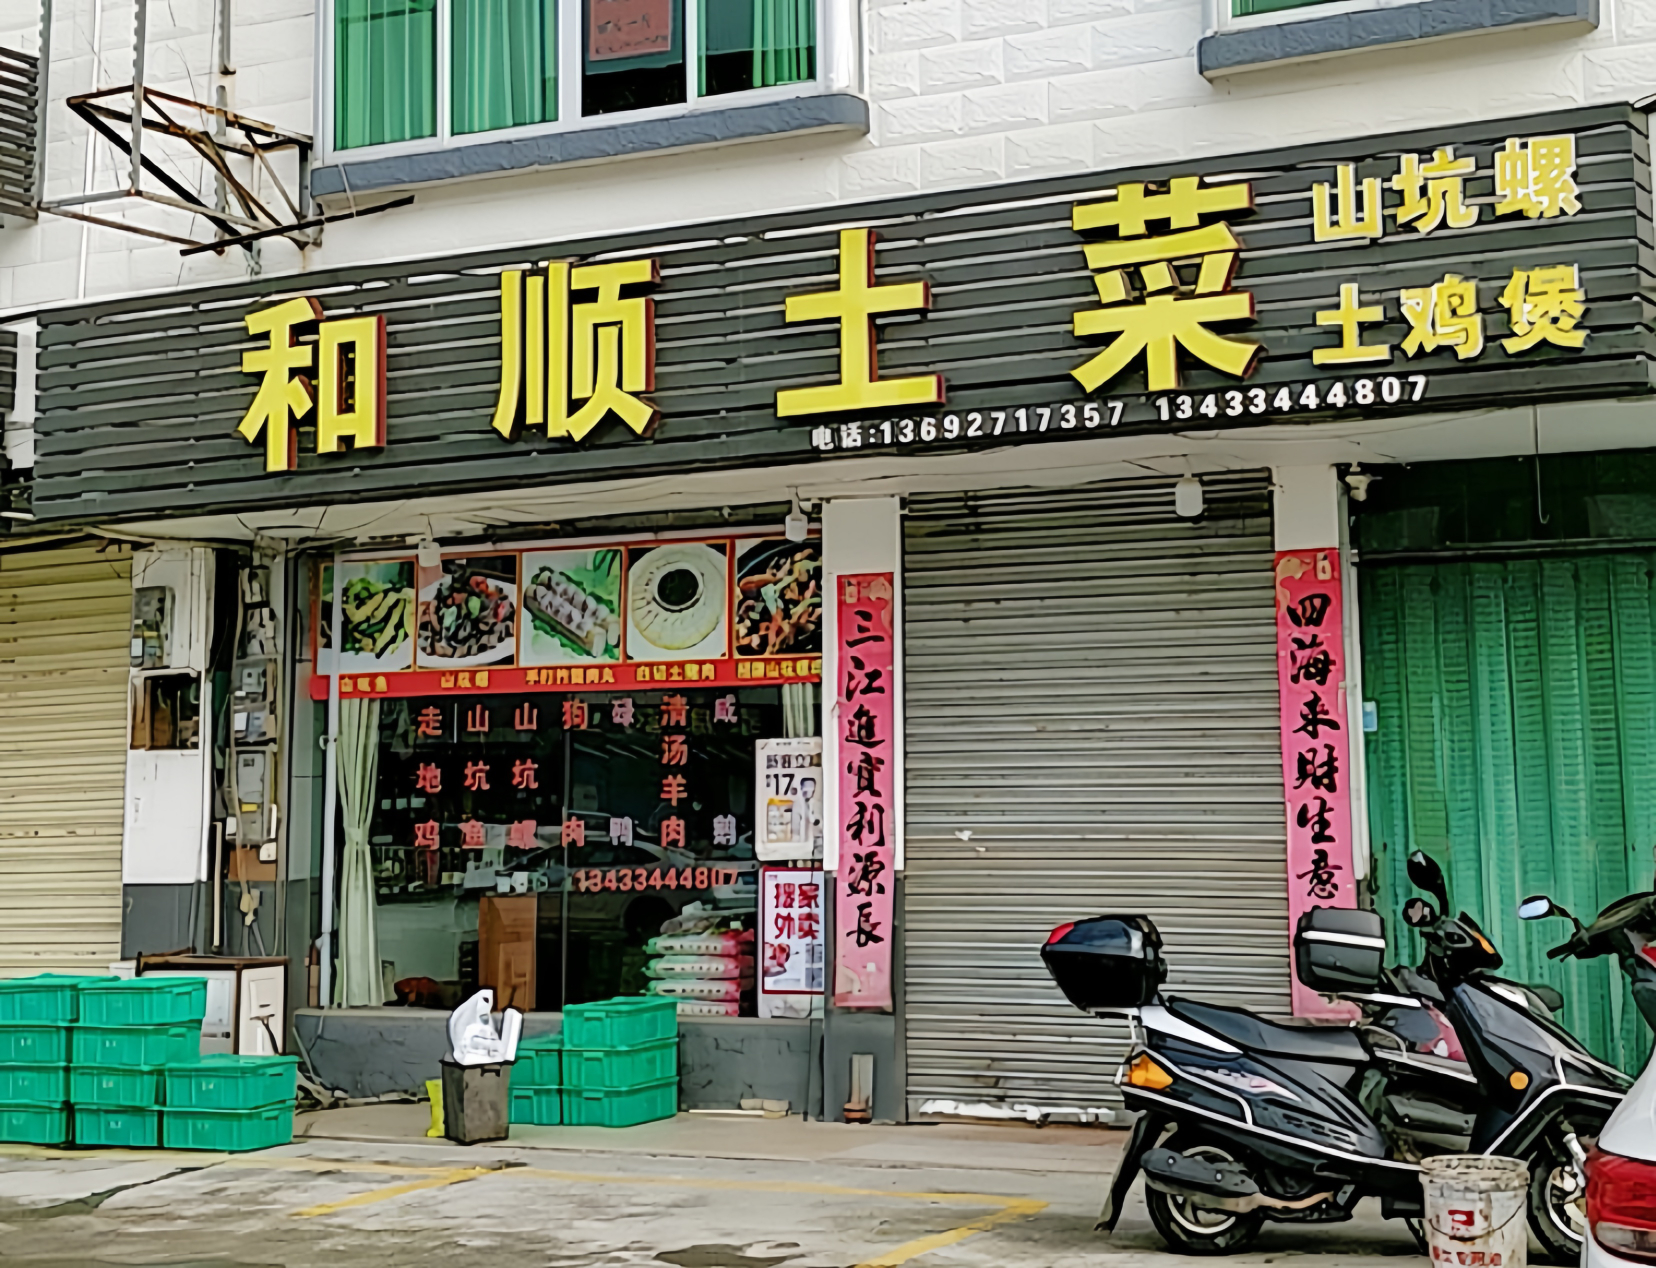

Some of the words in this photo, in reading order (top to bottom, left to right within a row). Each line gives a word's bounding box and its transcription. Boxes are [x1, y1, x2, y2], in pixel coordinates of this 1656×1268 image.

[1312, 133, 1583, 242] 山坑螺
[238, 175, 1263, 472] 和顺土菜
[1312, 265, 1590, 366] 土鸡煲
[1156, 375, 1426, 422] 13433444807
[414, 706, 443, 850] 走地鸡
[561, 697, 588, 847] 狗肉
[660, 694, 690, 847] 清汤羊肉
